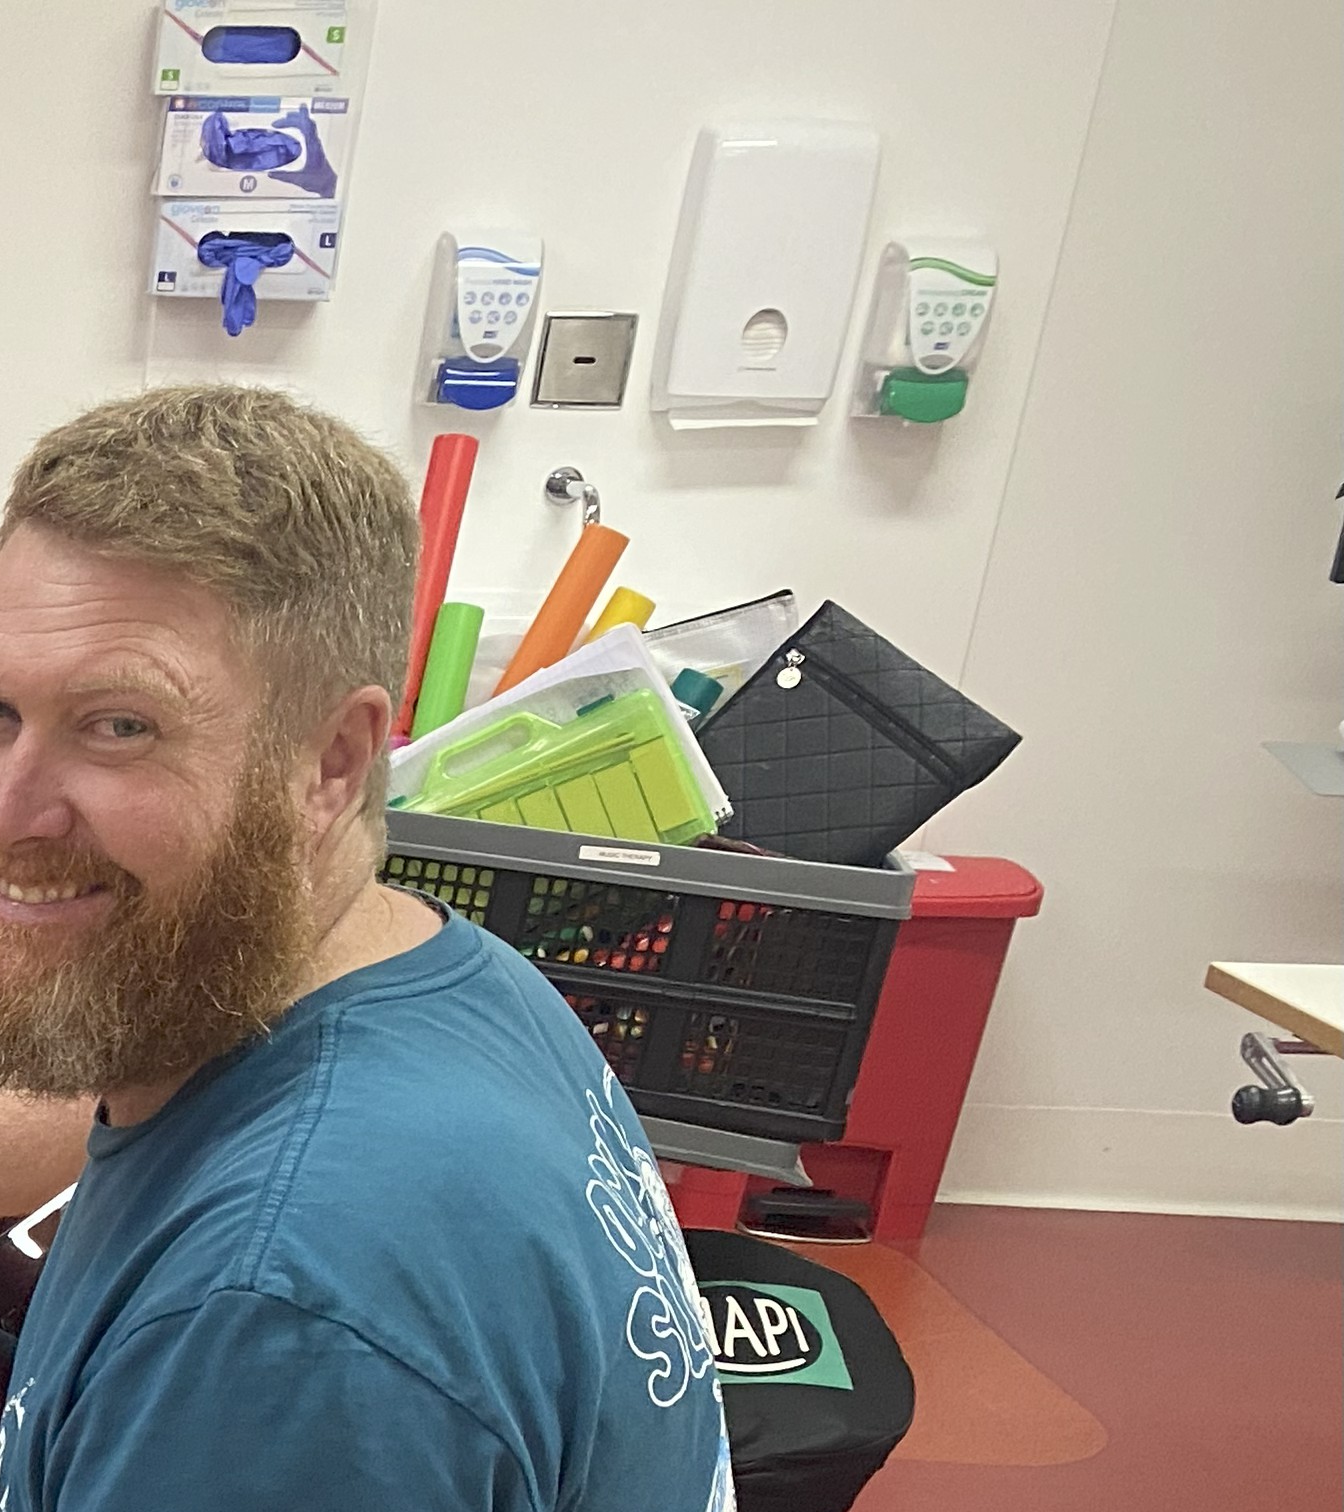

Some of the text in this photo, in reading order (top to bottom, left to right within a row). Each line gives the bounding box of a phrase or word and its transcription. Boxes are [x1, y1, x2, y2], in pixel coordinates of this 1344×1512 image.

[243, 178, 254, 191] M
[599, 851, 652, 862] MUSIC THERAPY
